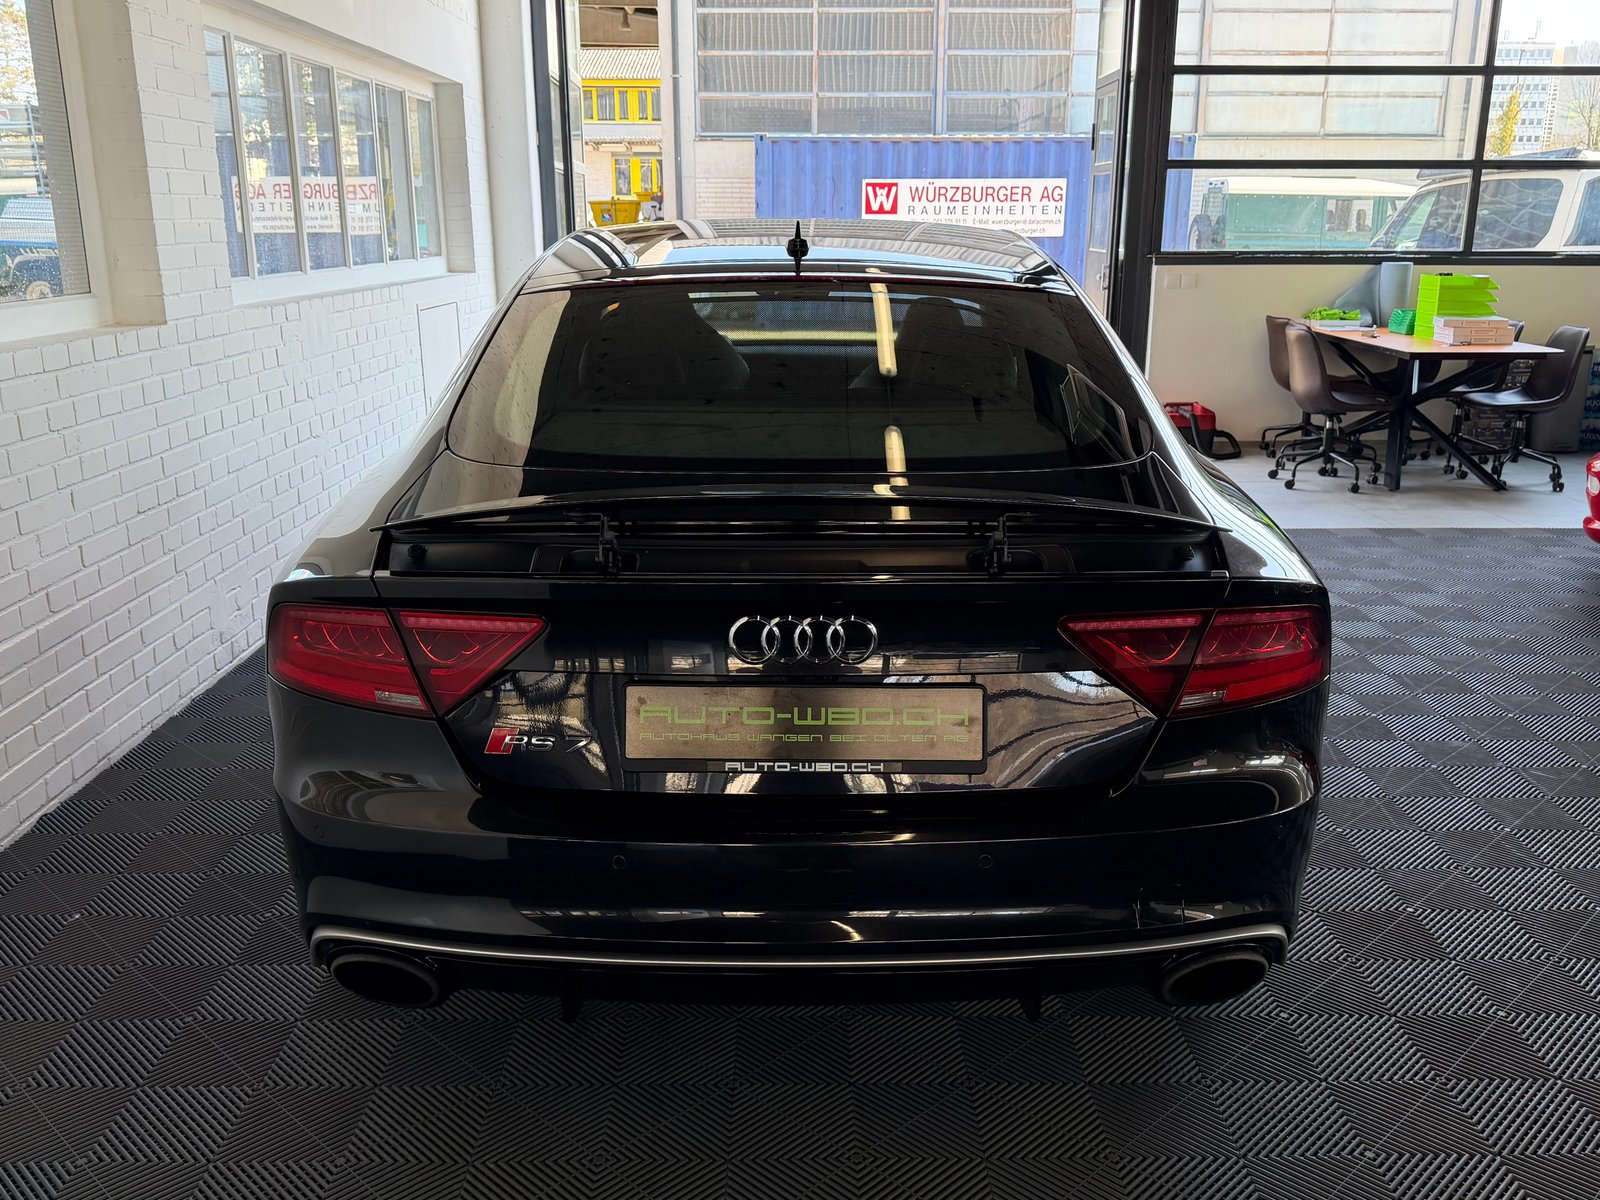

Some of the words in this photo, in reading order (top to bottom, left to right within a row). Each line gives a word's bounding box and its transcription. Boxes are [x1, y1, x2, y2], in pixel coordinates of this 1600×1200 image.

[909, 182, 1032, 203] WÜRZBURGER
[1040, 186, 1064, 203] AG
[907, 205, 1063, 216] RAUMEINHEITEN
[639, 706, 969, 727] AUTO-WBO.CH
[639, 732, 740, 741] AUTOHAUS
[747, 733, 823, 742] WANGEN
[829, 734, 867, 742] BEI
[874, 734, 937, 742] OLTEN
[943, 734, 969, 743] AG
[724, 761, 884, 772] AUTO-WBO.CH
